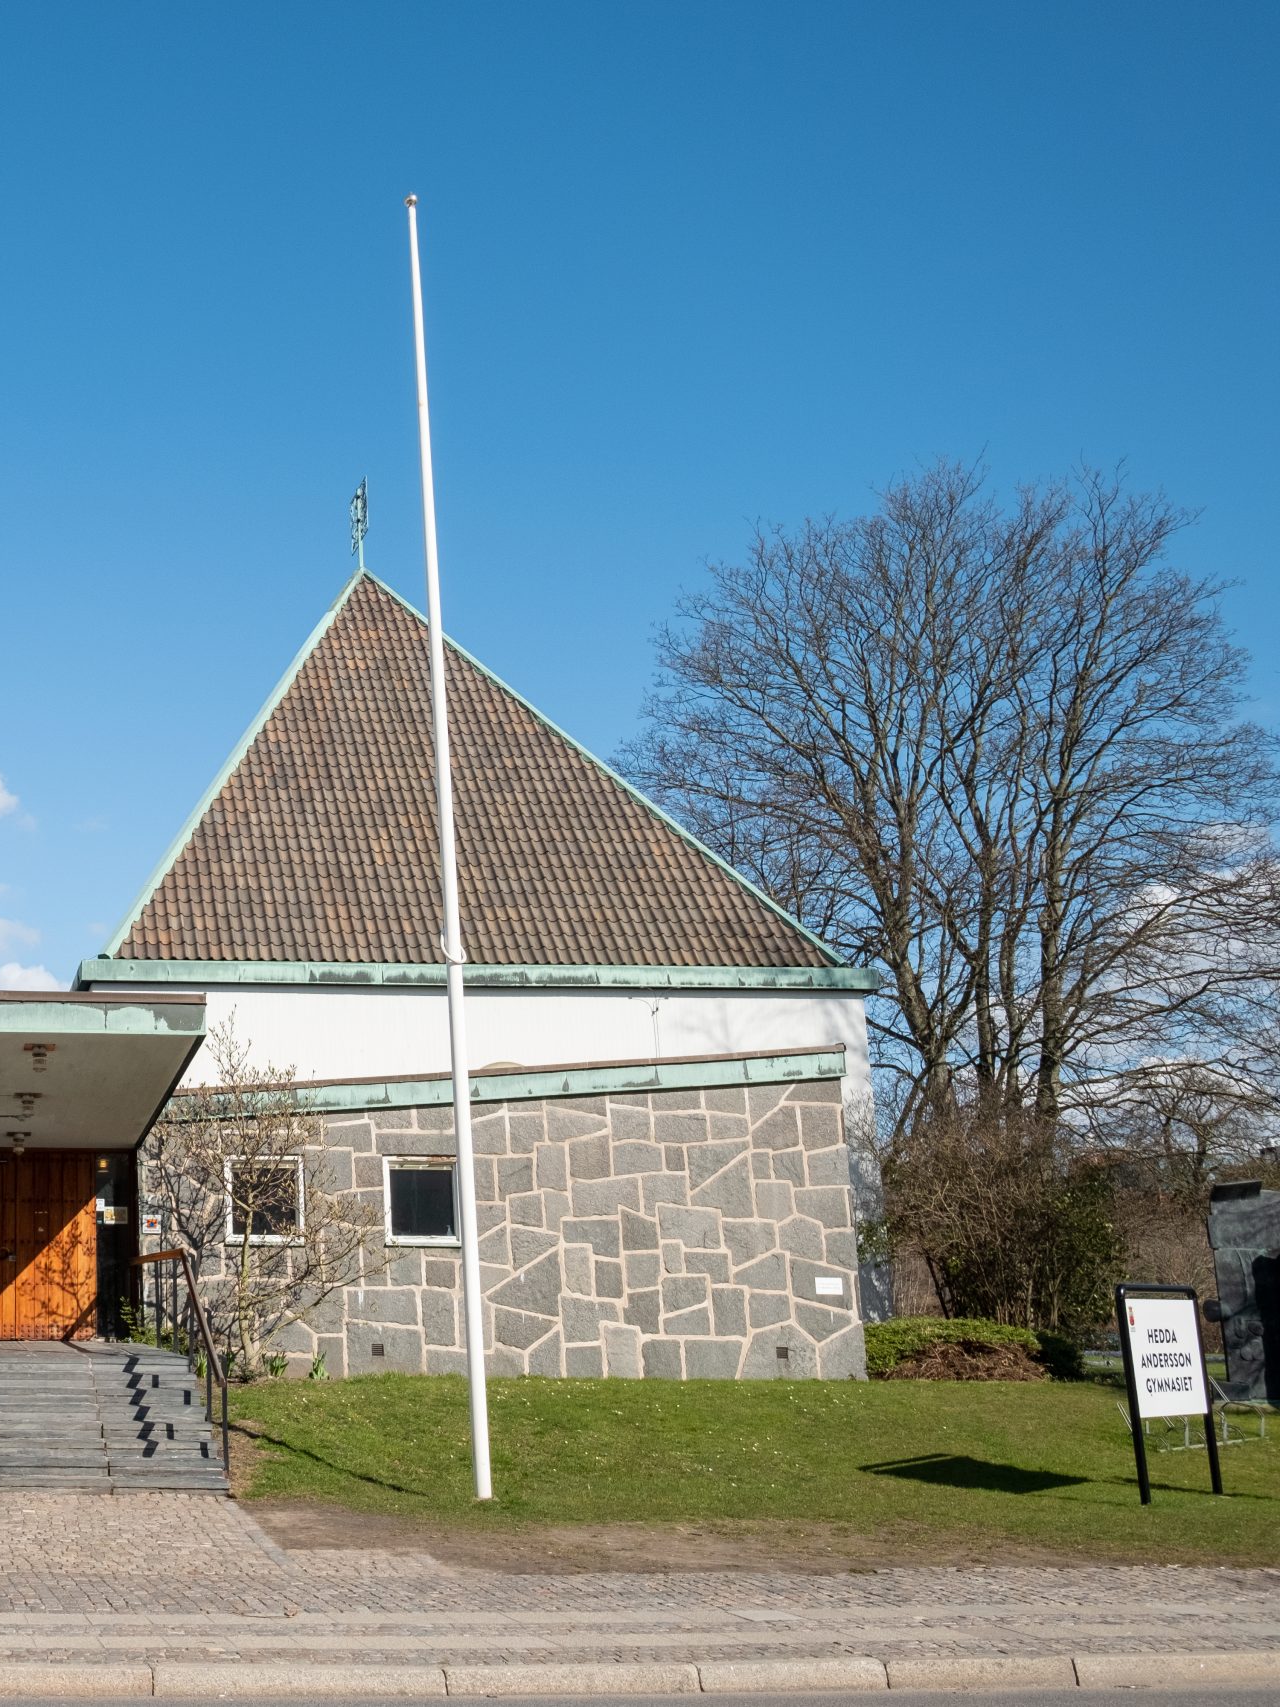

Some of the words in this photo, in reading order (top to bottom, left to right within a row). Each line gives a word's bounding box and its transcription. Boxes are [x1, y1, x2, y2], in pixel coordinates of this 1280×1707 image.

[1147, 1329, 1177, 1343] HEDDA
[1141, 1353, 1192, 1368] ANDERSSON
[1146, 1376, 1193, 1394] GYMNASIET
